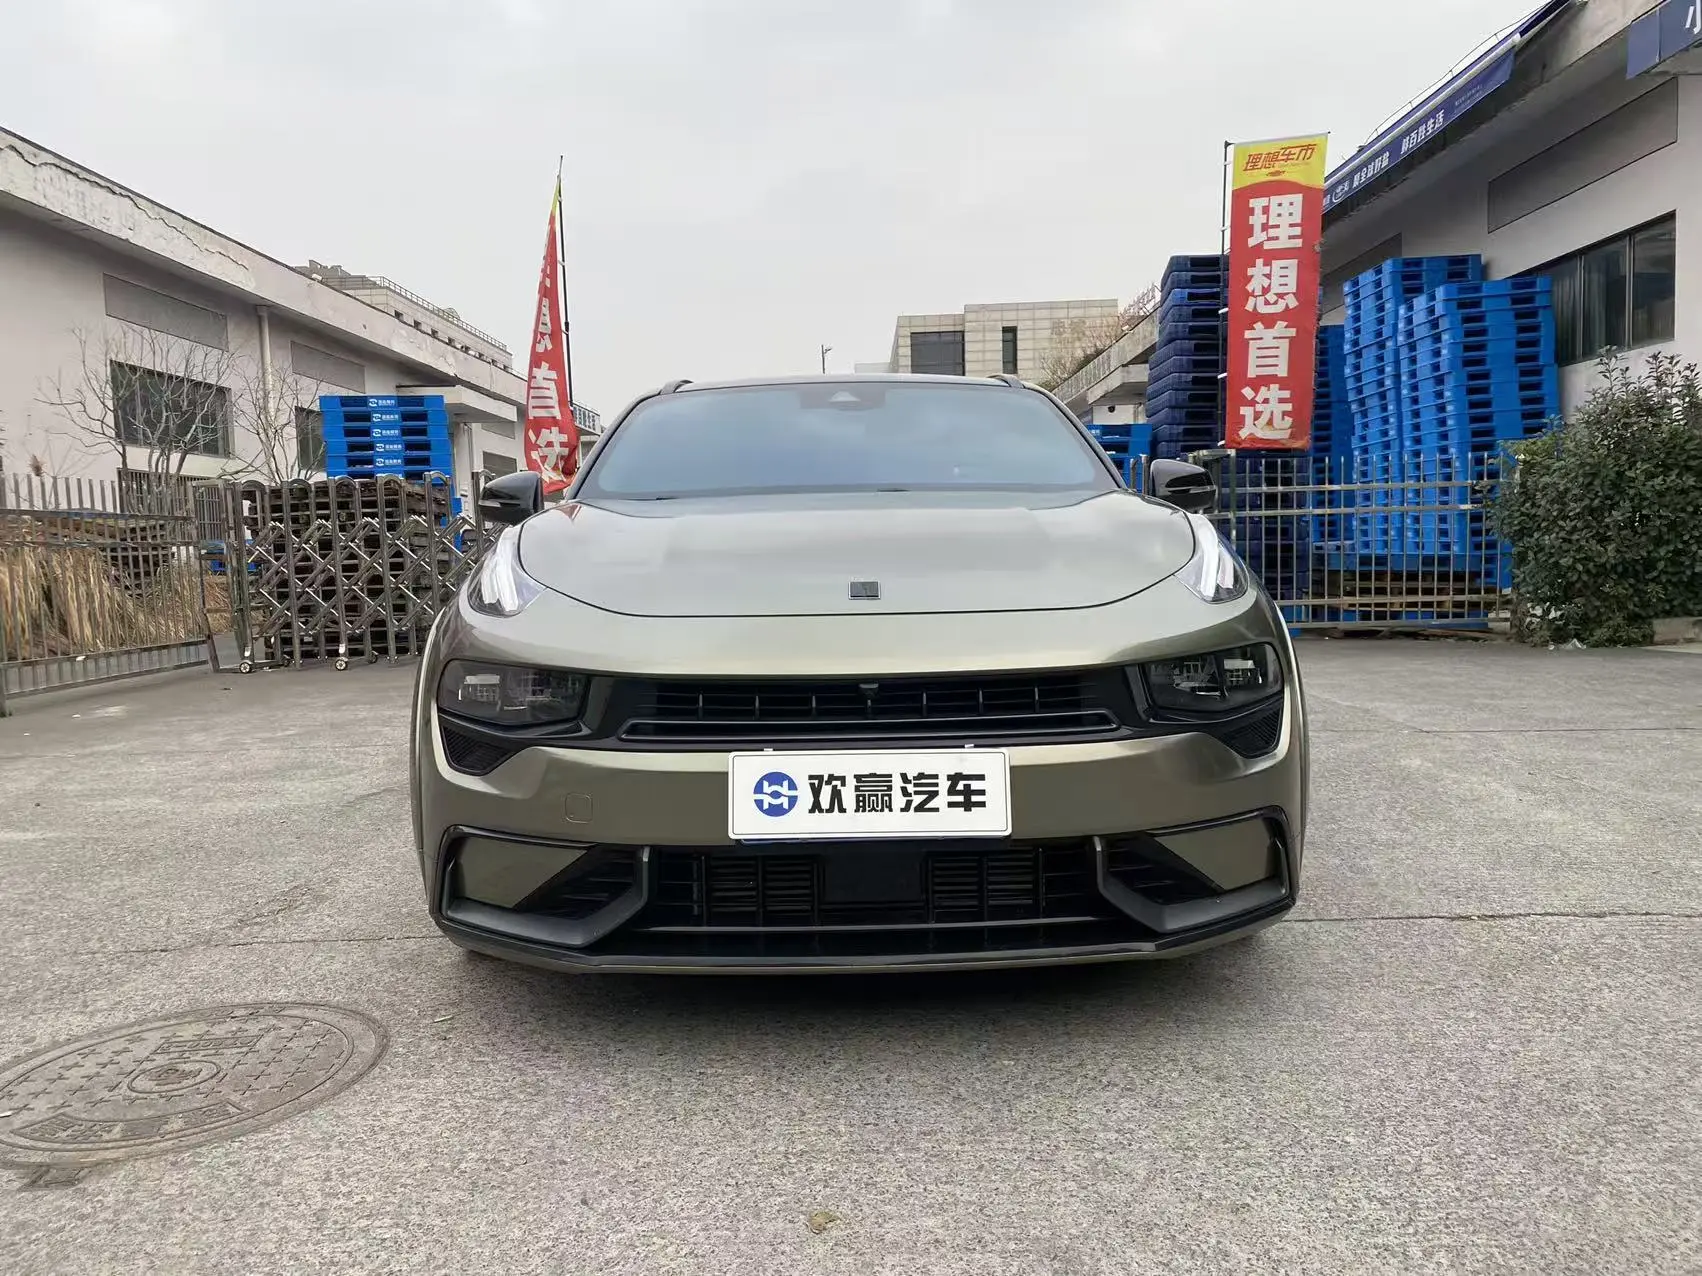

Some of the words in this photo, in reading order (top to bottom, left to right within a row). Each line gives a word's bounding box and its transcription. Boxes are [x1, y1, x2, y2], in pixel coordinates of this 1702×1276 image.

[1243, 143, 1317, 172] 理想车市
[1239, 193, 1303, 440] 理想首选
[807, 771, 986, 814] 欢赢汽车
